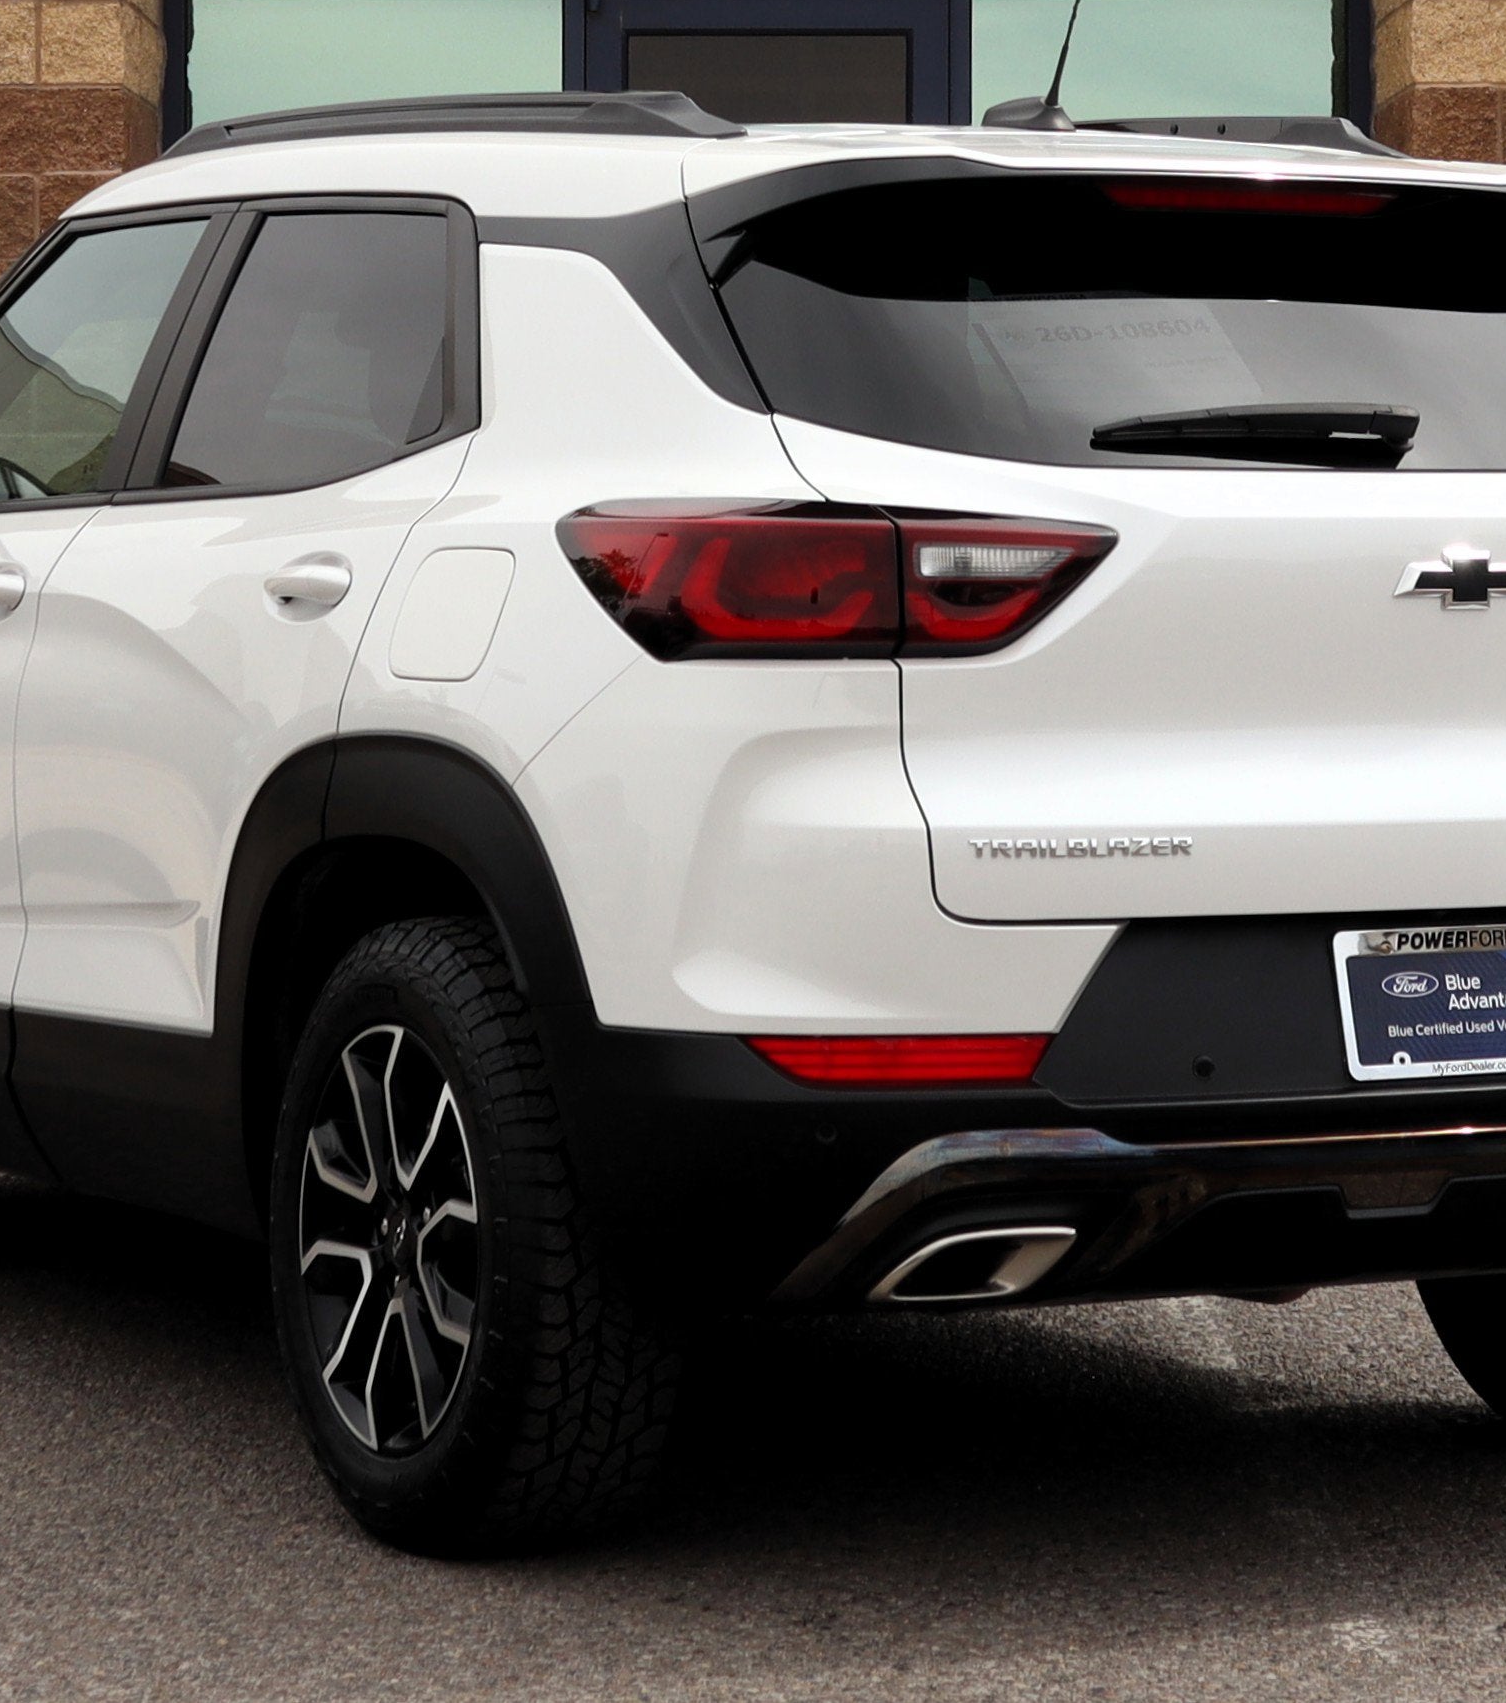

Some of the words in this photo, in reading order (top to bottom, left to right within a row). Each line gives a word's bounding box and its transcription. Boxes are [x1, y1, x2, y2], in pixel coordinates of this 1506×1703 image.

[969, 836, 1194, 859] TRAILBLAZER
[1392, 975, 1428, 994] Ford
[1445, 974, 1481, 991] Blue
[1388, 1025, 1415, 1038] Blue
[1415, 1021, 1464, 1036] Certified
[1465, 1020, 1495, 1034] Used
